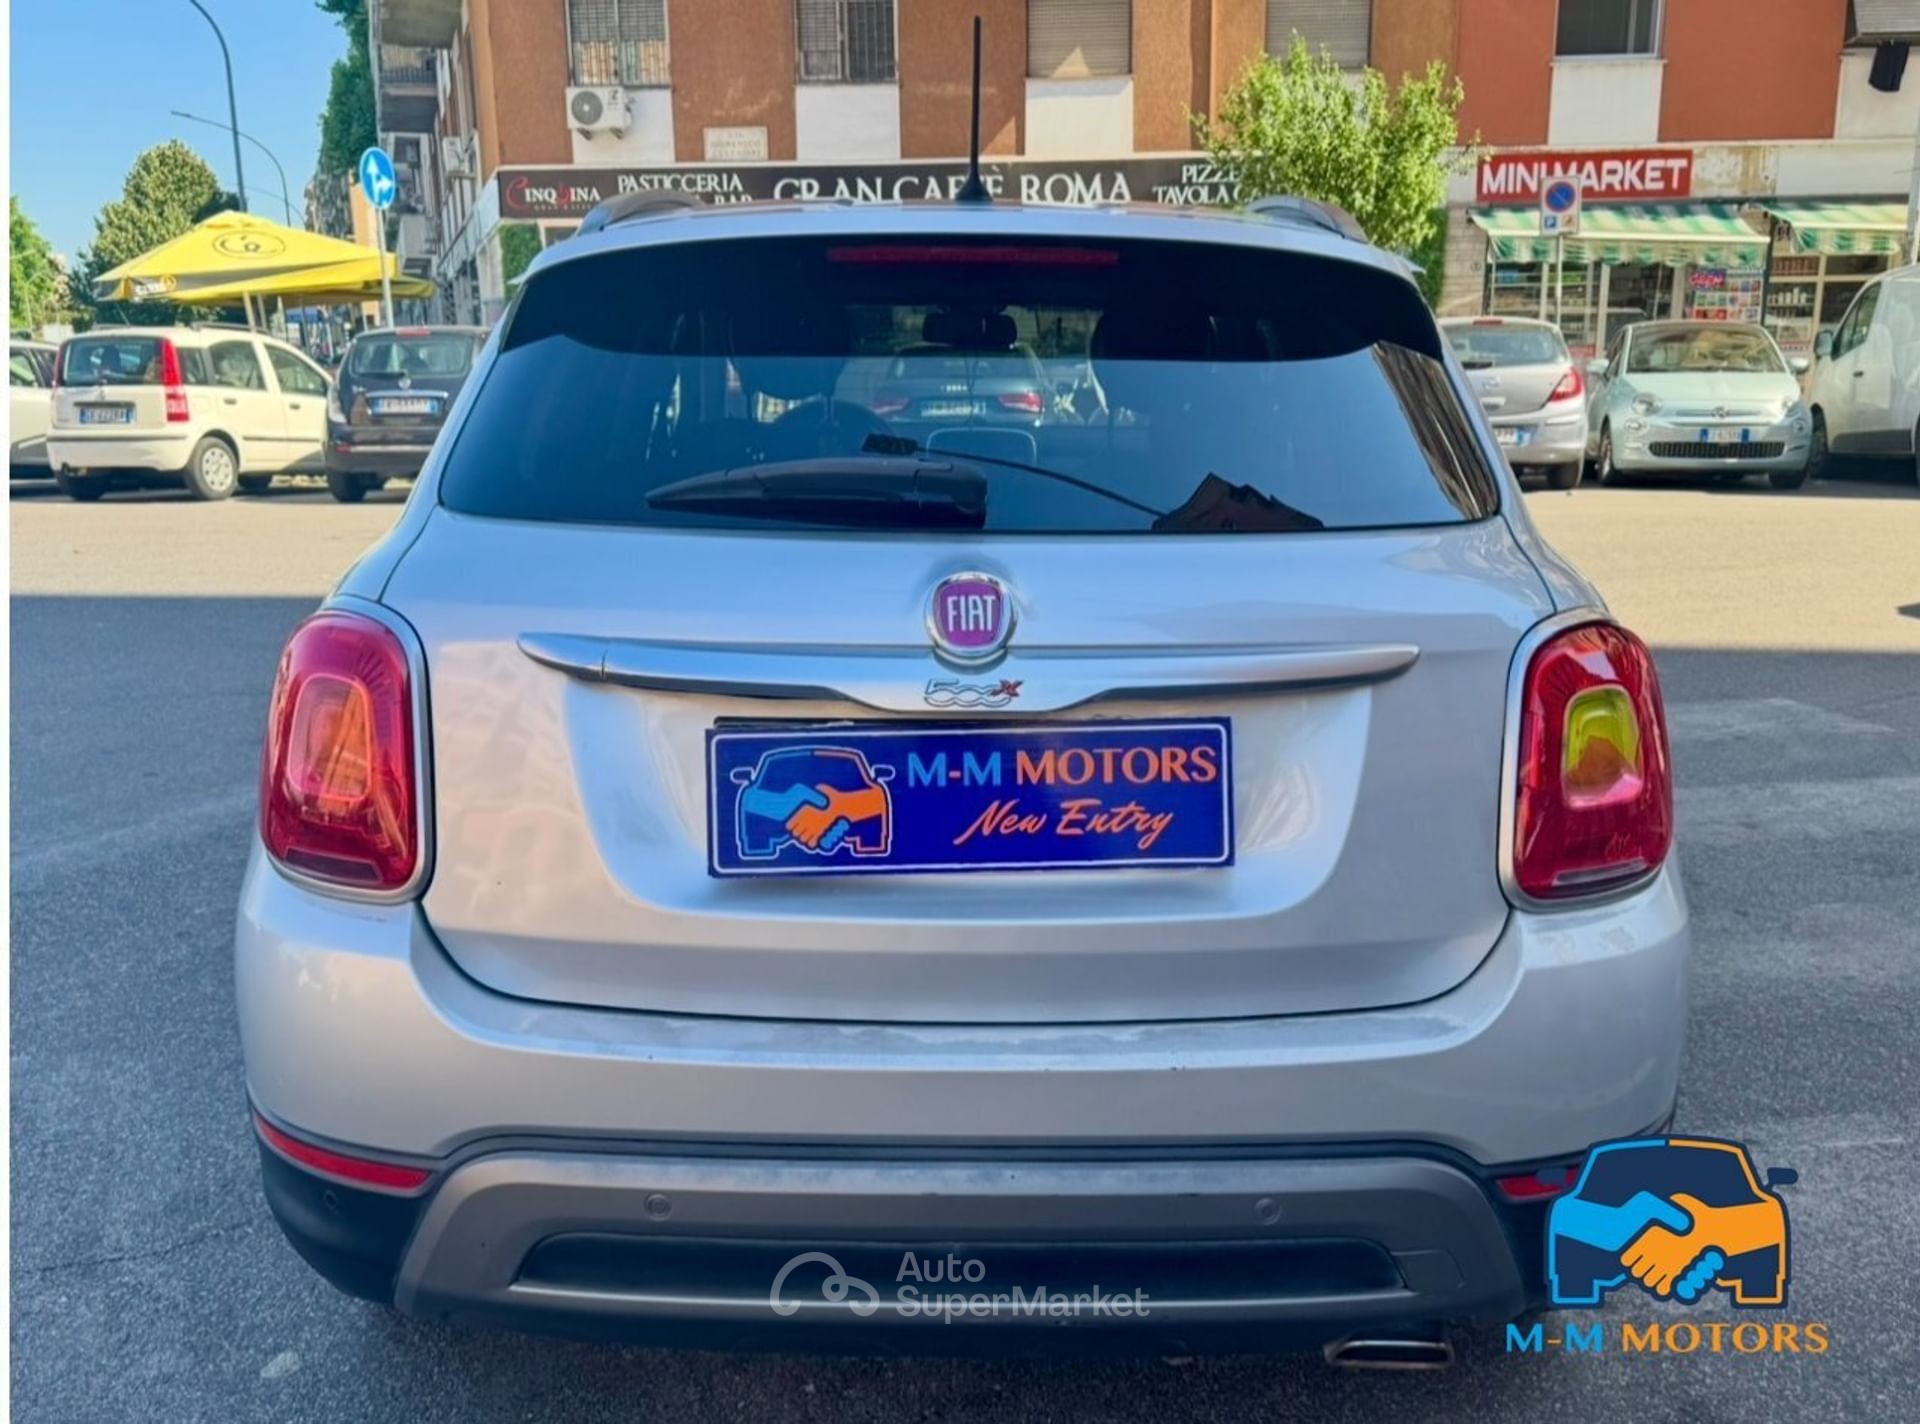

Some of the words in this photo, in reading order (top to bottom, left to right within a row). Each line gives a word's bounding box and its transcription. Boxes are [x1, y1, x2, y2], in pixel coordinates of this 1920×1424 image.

[617, 173, 744, 193] PASTICCERIA
[773, 177, 883, 204] GRAN
[893, 165, 1005, 202] CAFÈ
[1020, 172, 1132, 206] ROMA
[1182, 164, 1242, 184] PIZZE
[1152, 185, 1232, 205] TAVOLA
[947, 594, 997, 632] FIAT
[907, 751, 1002, 788] M-M
[1015, 746, 1217, 787] MOTORS
[952, 799, 1047, 846] New
[1056, 798, 1175, 850] Entry
